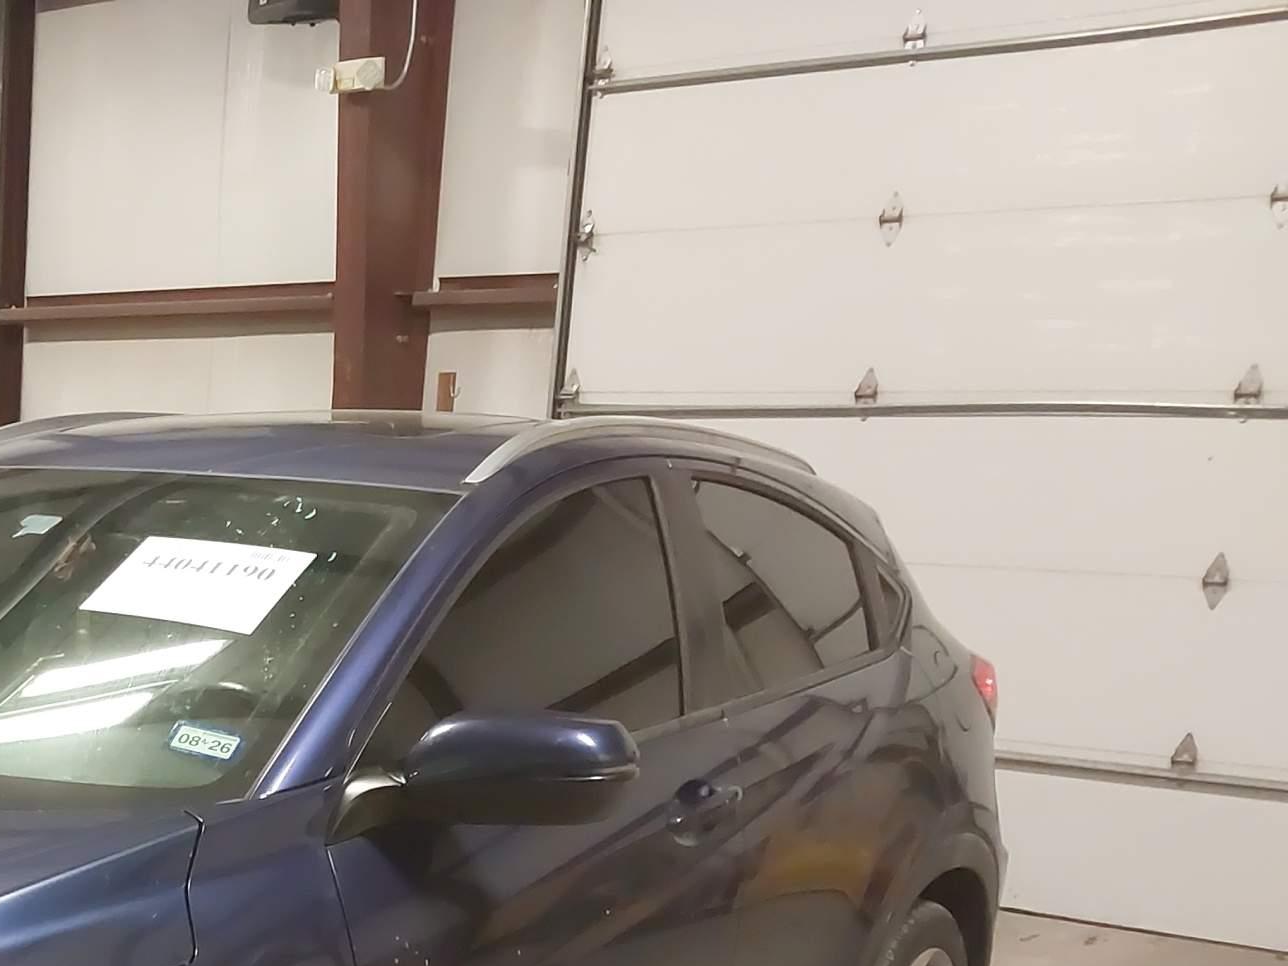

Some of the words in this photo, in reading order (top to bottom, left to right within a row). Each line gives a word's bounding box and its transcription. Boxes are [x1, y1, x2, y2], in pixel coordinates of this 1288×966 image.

[142, 554, 277, 581] 44041190
[177, 733, 202, 747] 08
[207, 739, 233, 754] 26
